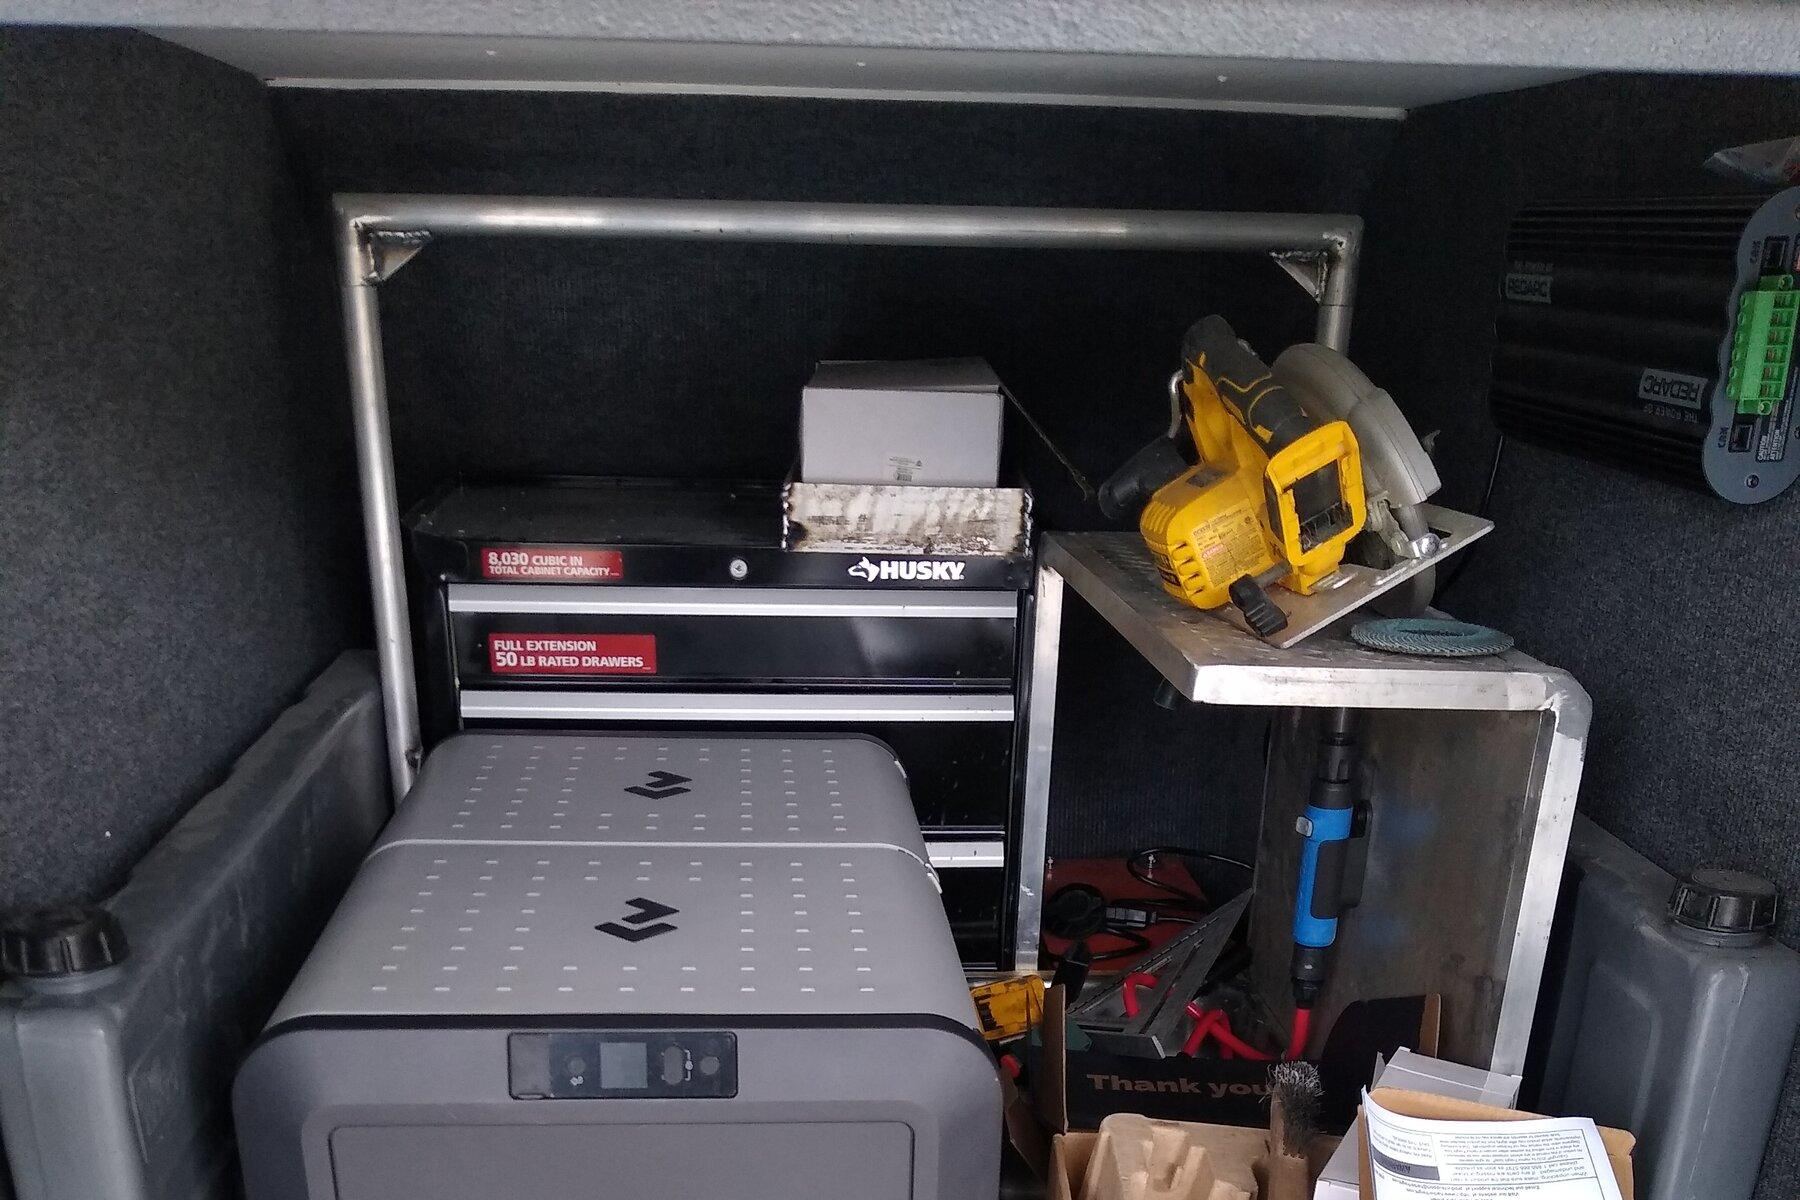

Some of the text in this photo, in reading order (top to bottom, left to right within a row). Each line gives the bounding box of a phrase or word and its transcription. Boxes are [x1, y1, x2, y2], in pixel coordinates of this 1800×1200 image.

[1642, 375, 1700, 403] REDARC
[488, 552, 583, 566] 8,030 CUBIC IN
[489, 566, 610, 577] TOTAL CABINET CAPACITY
[880, 560, 965, 581] HUSKY
[494, 640, 597, 652] FULL EXTENSION
[495, 653, 644, 668] 50 LB RATED DRAWERS
[1086, 1073, 1267, 1099] Thank you
